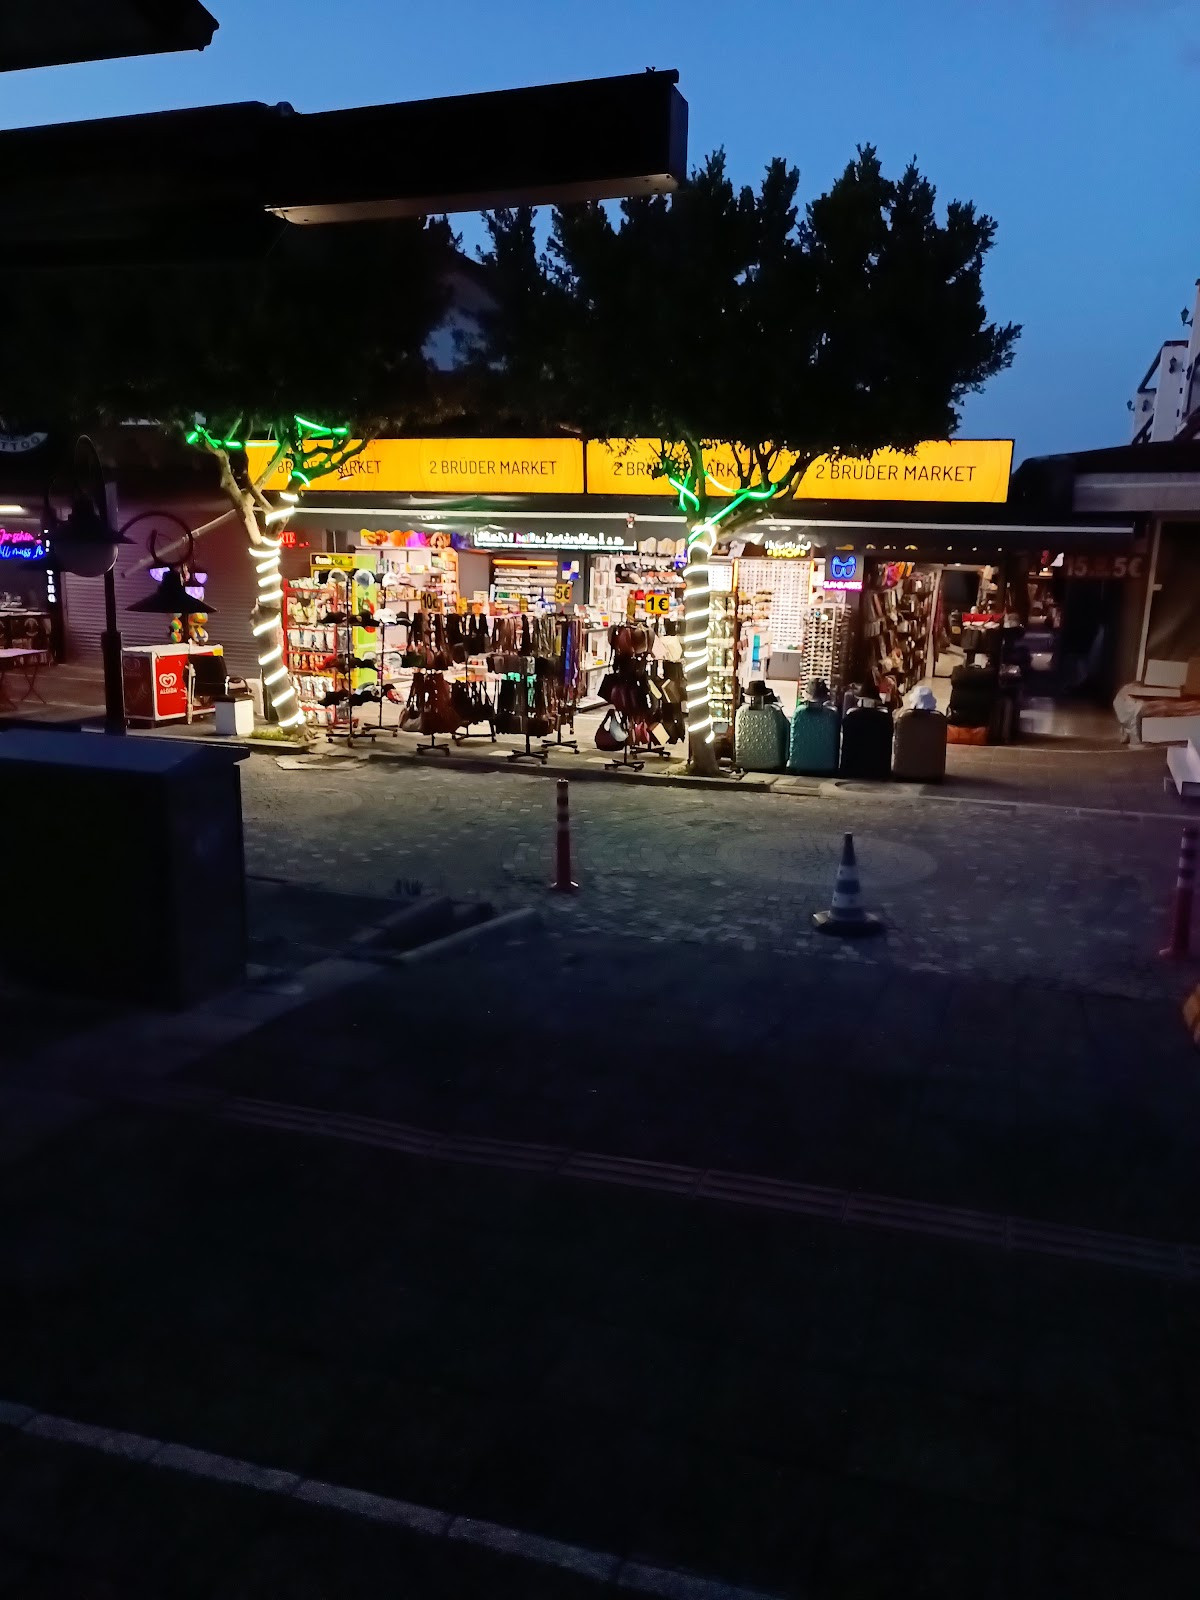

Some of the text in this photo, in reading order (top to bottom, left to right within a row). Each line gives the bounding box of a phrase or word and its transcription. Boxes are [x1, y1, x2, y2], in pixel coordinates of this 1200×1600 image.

[430, 457, 557, 475] 2 BRÜDER MARKET
[816, 464, 825, 479] 2
[904, 465, 976, 482] MARKET
[556, 585, 571, 599] 5€
